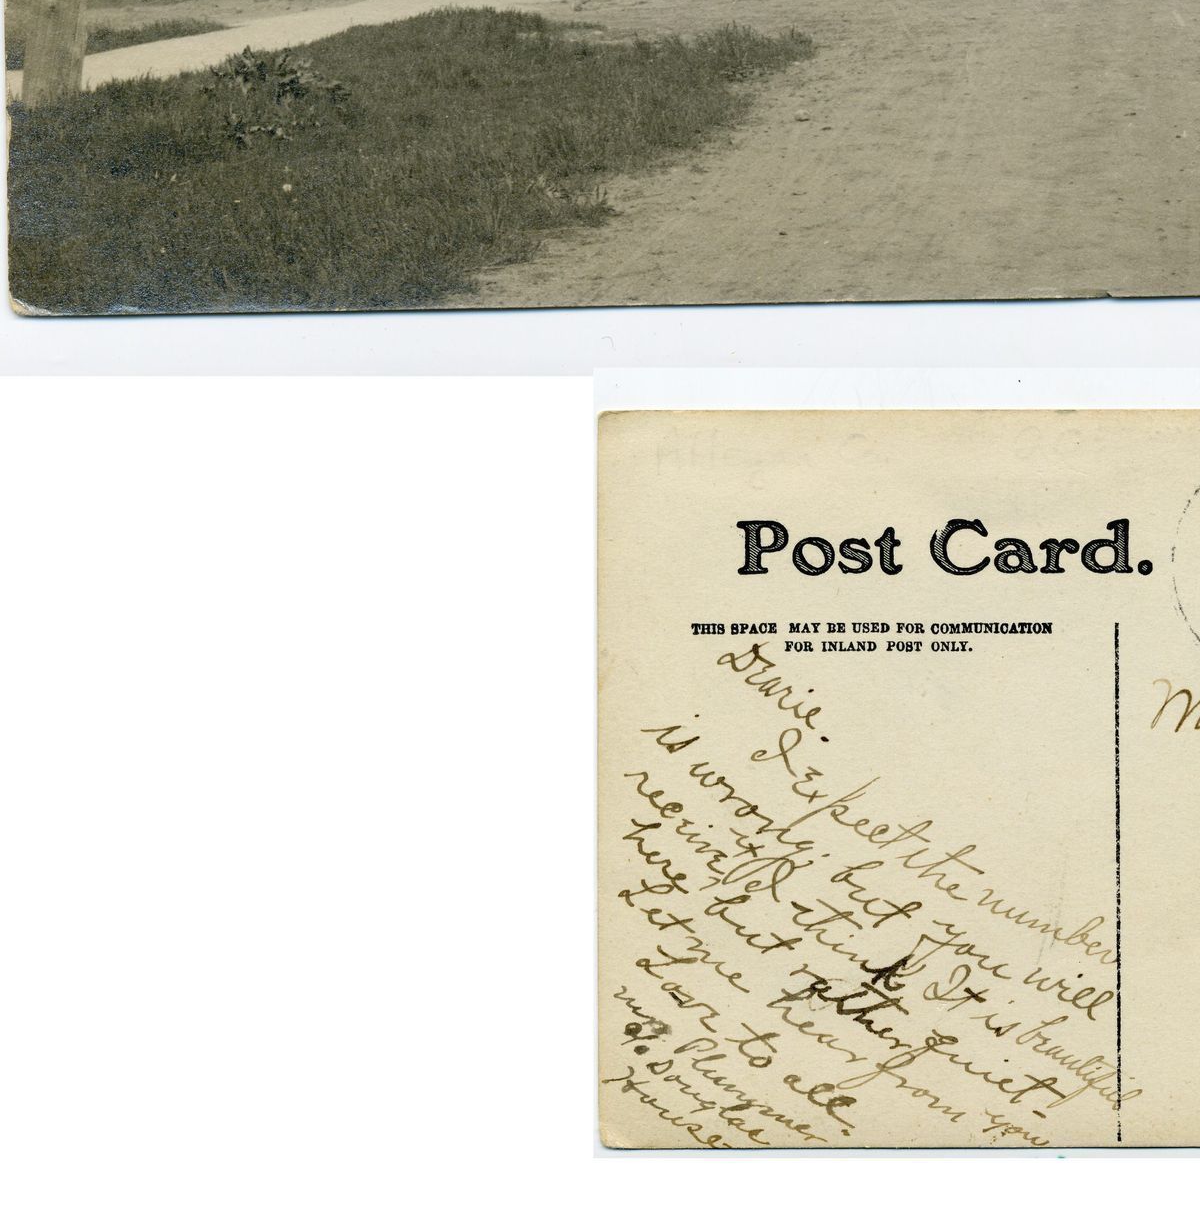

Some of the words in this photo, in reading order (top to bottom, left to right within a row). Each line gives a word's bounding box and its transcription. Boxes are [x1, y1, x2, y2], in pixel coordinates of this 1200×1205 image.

[736, 519, 903, 576] Post
[929, 518, 1154, 576] Card.
[691, 622, 725, 635] THIS
[730, 622, 778, 634] SPACE
[788, 622, 821, 634] MAY
[826, 622, 846, 634] BE
[851, 622, 890, 634] USED
[896, 622, 925, 634] FOR
[930, 622, 1053, 635] COMMUNICATION
[784, 640, 814, 653] FOR
[821, 640, 877, 653] INLAND
[886, 640, 923, 653] POST
[930, 640, 974, 653] ONLY.
[640, 713, 701, 754] is
[829, 860, 923, 930] but
[900, 917, 1012, 981] you
[1022, 966, 1115, 1021] will
[703, 893, 804, 955] but
[895, 844, 985, 902] the
[977, 887, 1119, 965] number
[922, 963, 991, 1012] It
[969, 1000, 1022, 1037] is
[684, 935, 751, 994] me
[765, 987, 869, 1064] hear
[834, 1046, 968, 1123] from
[981, 1107, 1050, 1147] you
[723, 1021, 781, 1069] to
